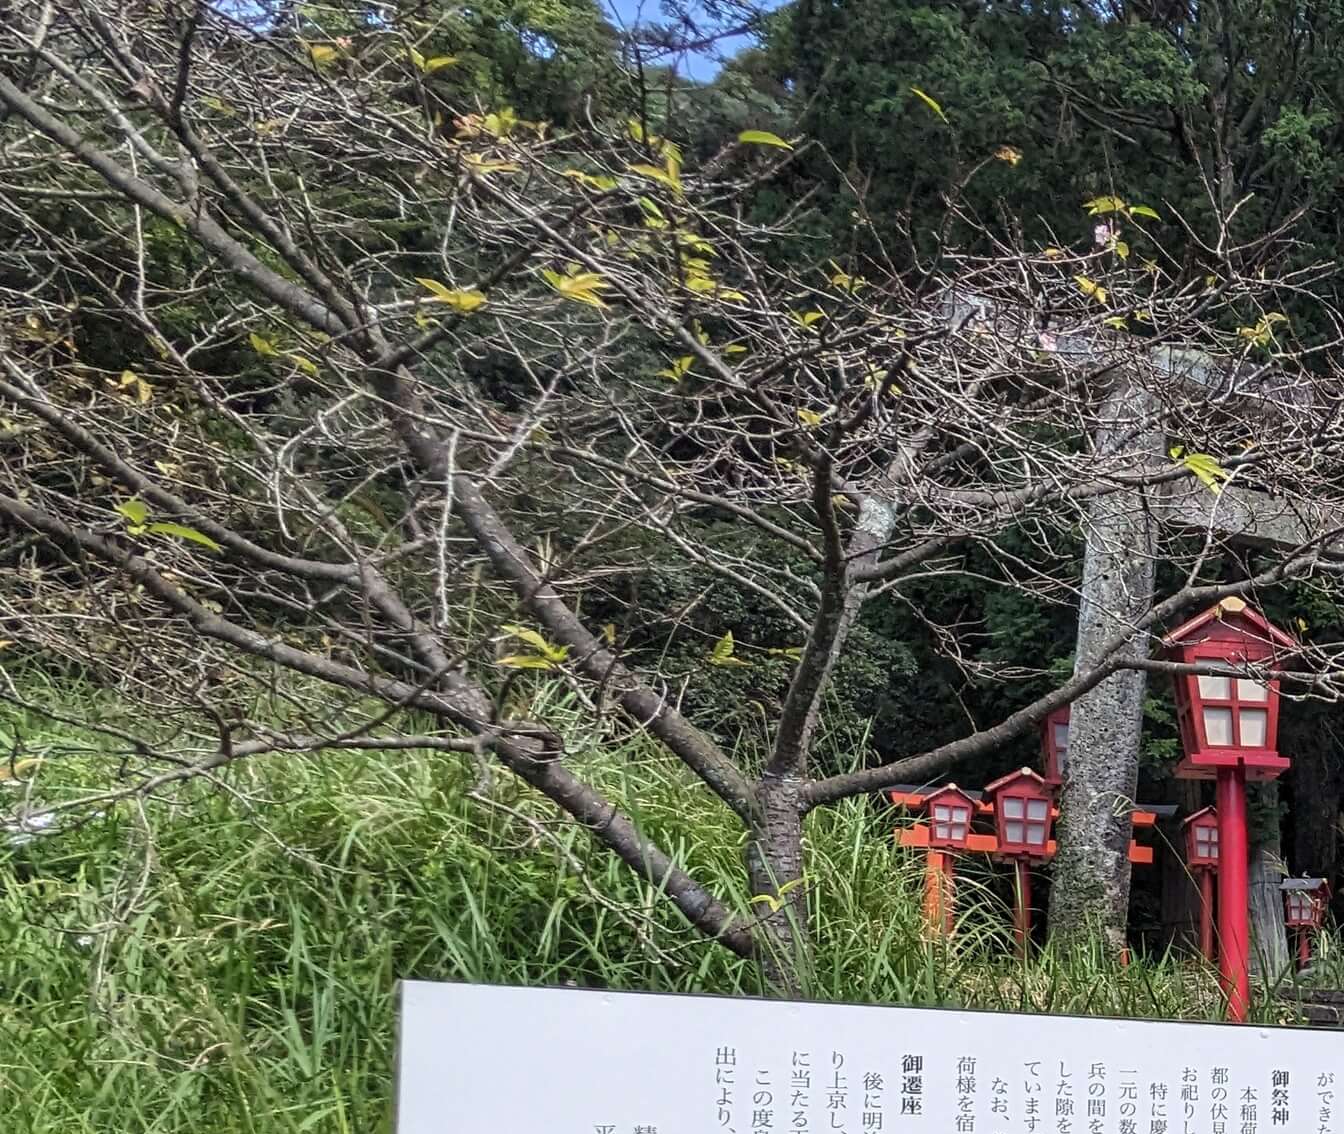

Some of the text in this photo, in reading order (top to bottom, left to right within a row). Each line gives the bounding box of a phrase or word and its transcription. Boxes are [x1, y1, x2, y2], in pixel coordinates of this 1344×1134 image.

[899, 1053, 924, 1116] 御遷座
[1271, 1069, 1290, 1126] 御祭神
